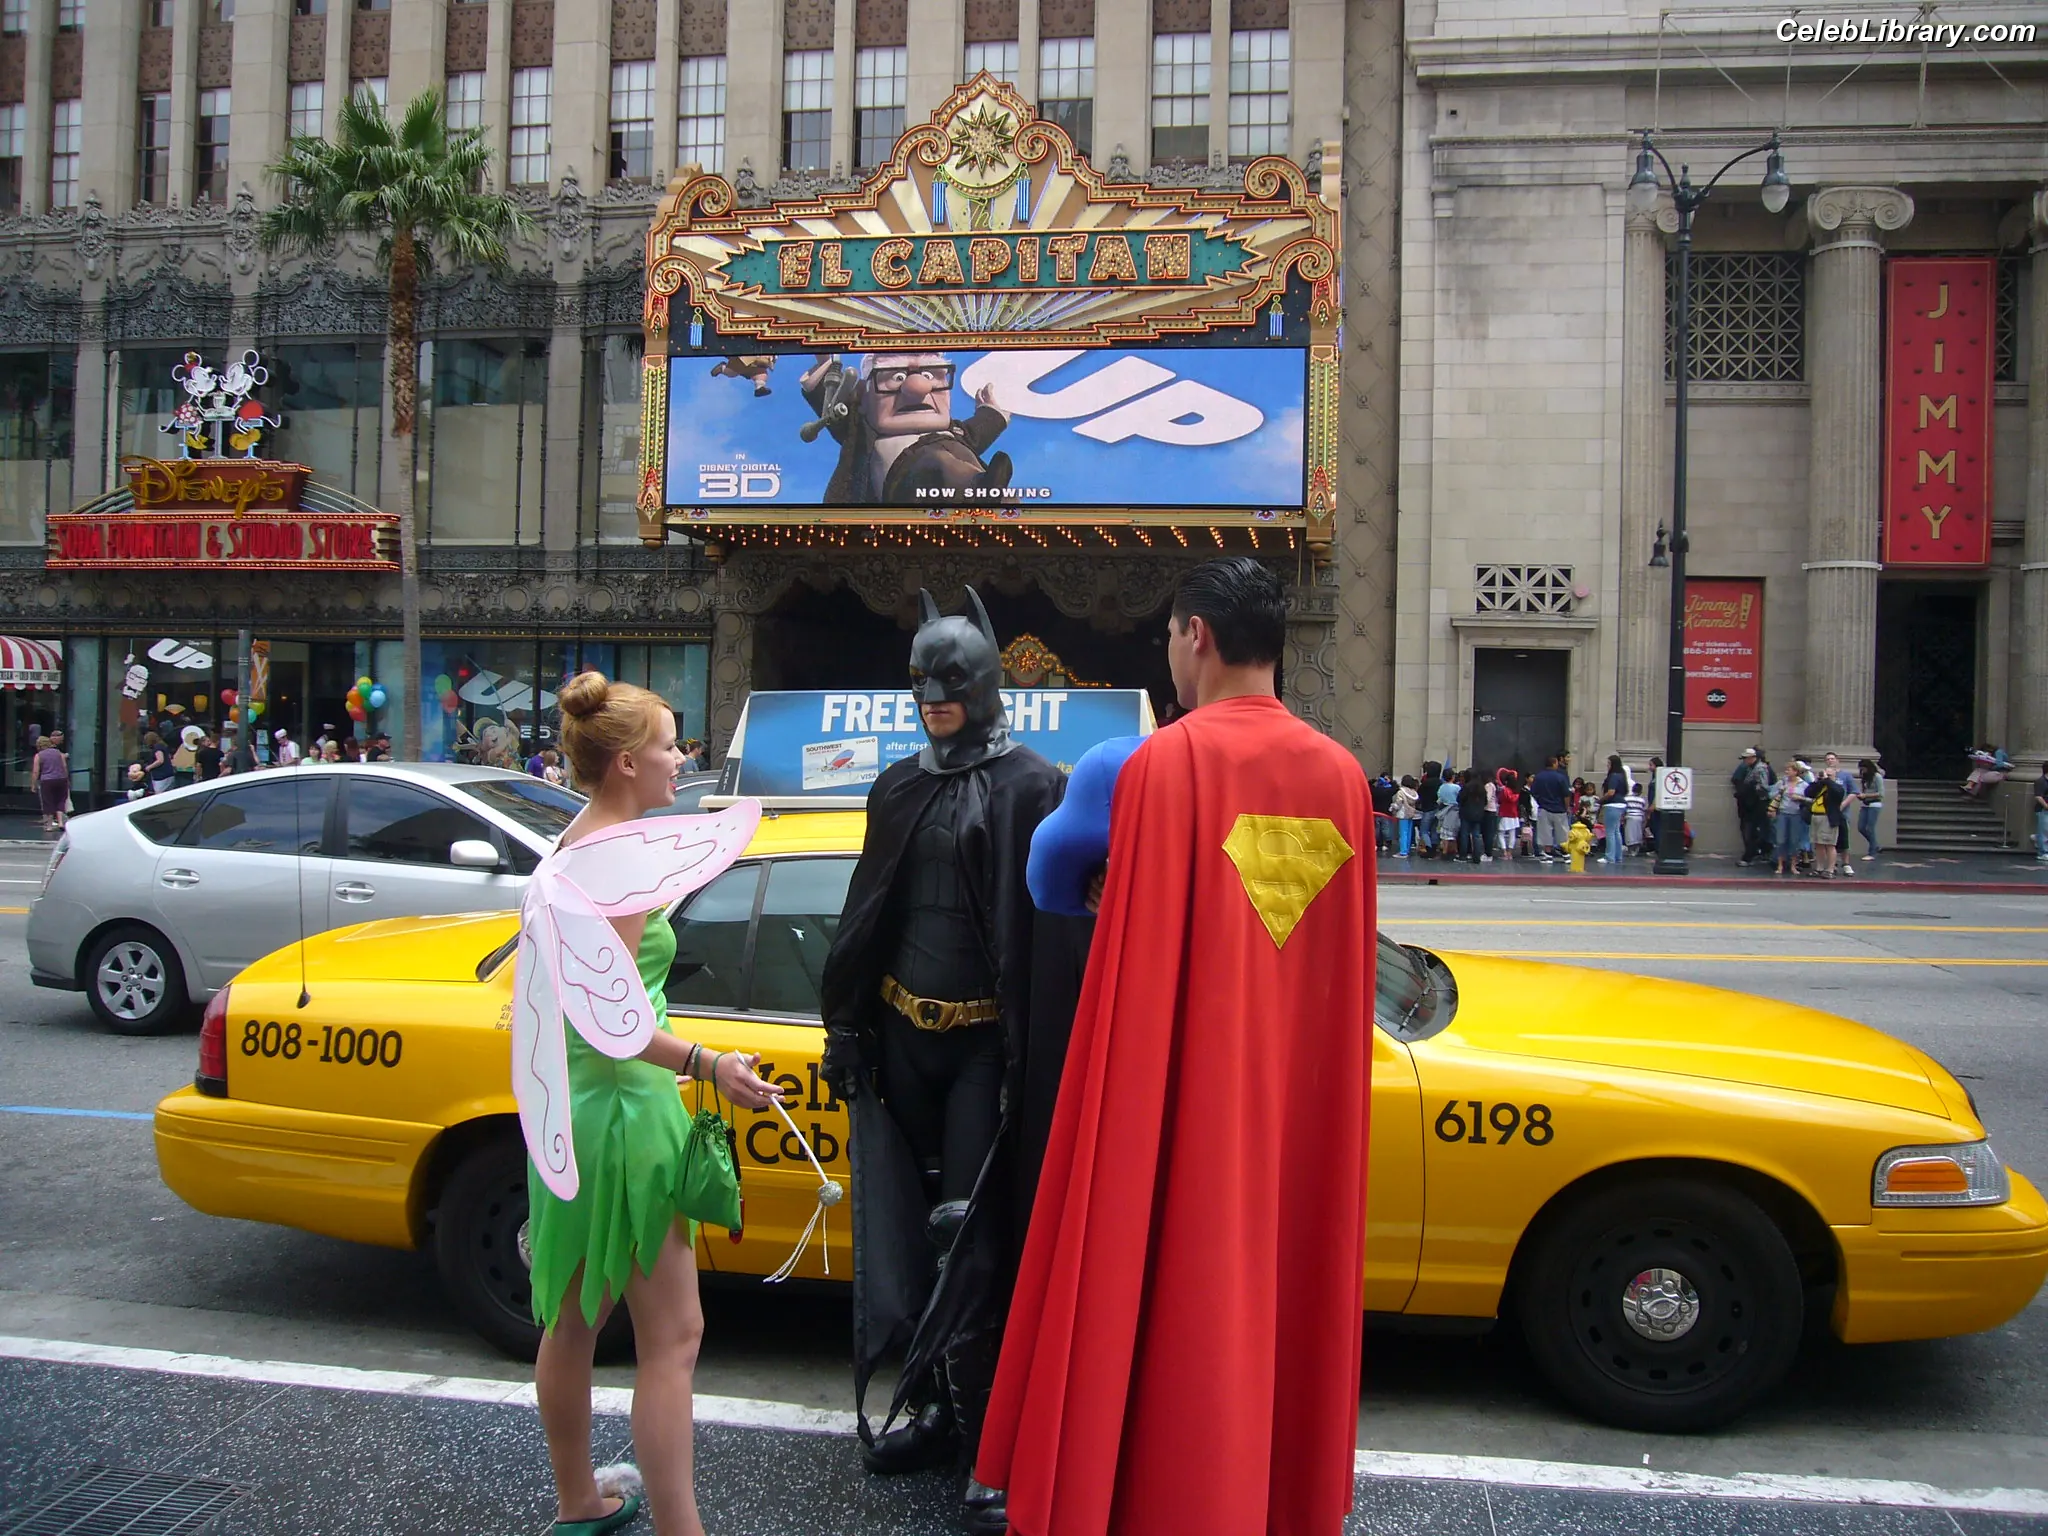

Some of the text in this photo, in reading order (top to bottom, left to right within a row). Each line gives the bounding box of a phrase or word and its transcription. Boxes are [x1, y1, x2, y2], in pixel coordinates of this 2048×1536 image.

[777, 234, 1191, 289] EL CAPITAN
[960, 350, 1265, 446] UP
[1917, 284, 1957, 540] JIMMY
[699, 463, 782, 472] DISNEY DIGITAL
[699, 472, 780, 498] 3D
[915, 488, 1051, 498] NOW SHOWING
[56, 523, 377, 559] SODA FOUNTAIN & STUDIO STORE
[1684, 594, 1738, 617] Jimmy
[1684, 613, 1738, 630] Kimmel
[148, 638, 214, 669] UP
[1707, 693, 1727, 702] abc
[821, 693, 918, 732] FREE
[806, 743, 842, 753] SOUTHWEST
[885, 741, 929, 752] after first
[861, 772, 877, 781] VISA
[241, 1020, 403, 1068] 808-1000
[1434, 1100, 1554, 1147] 6198
